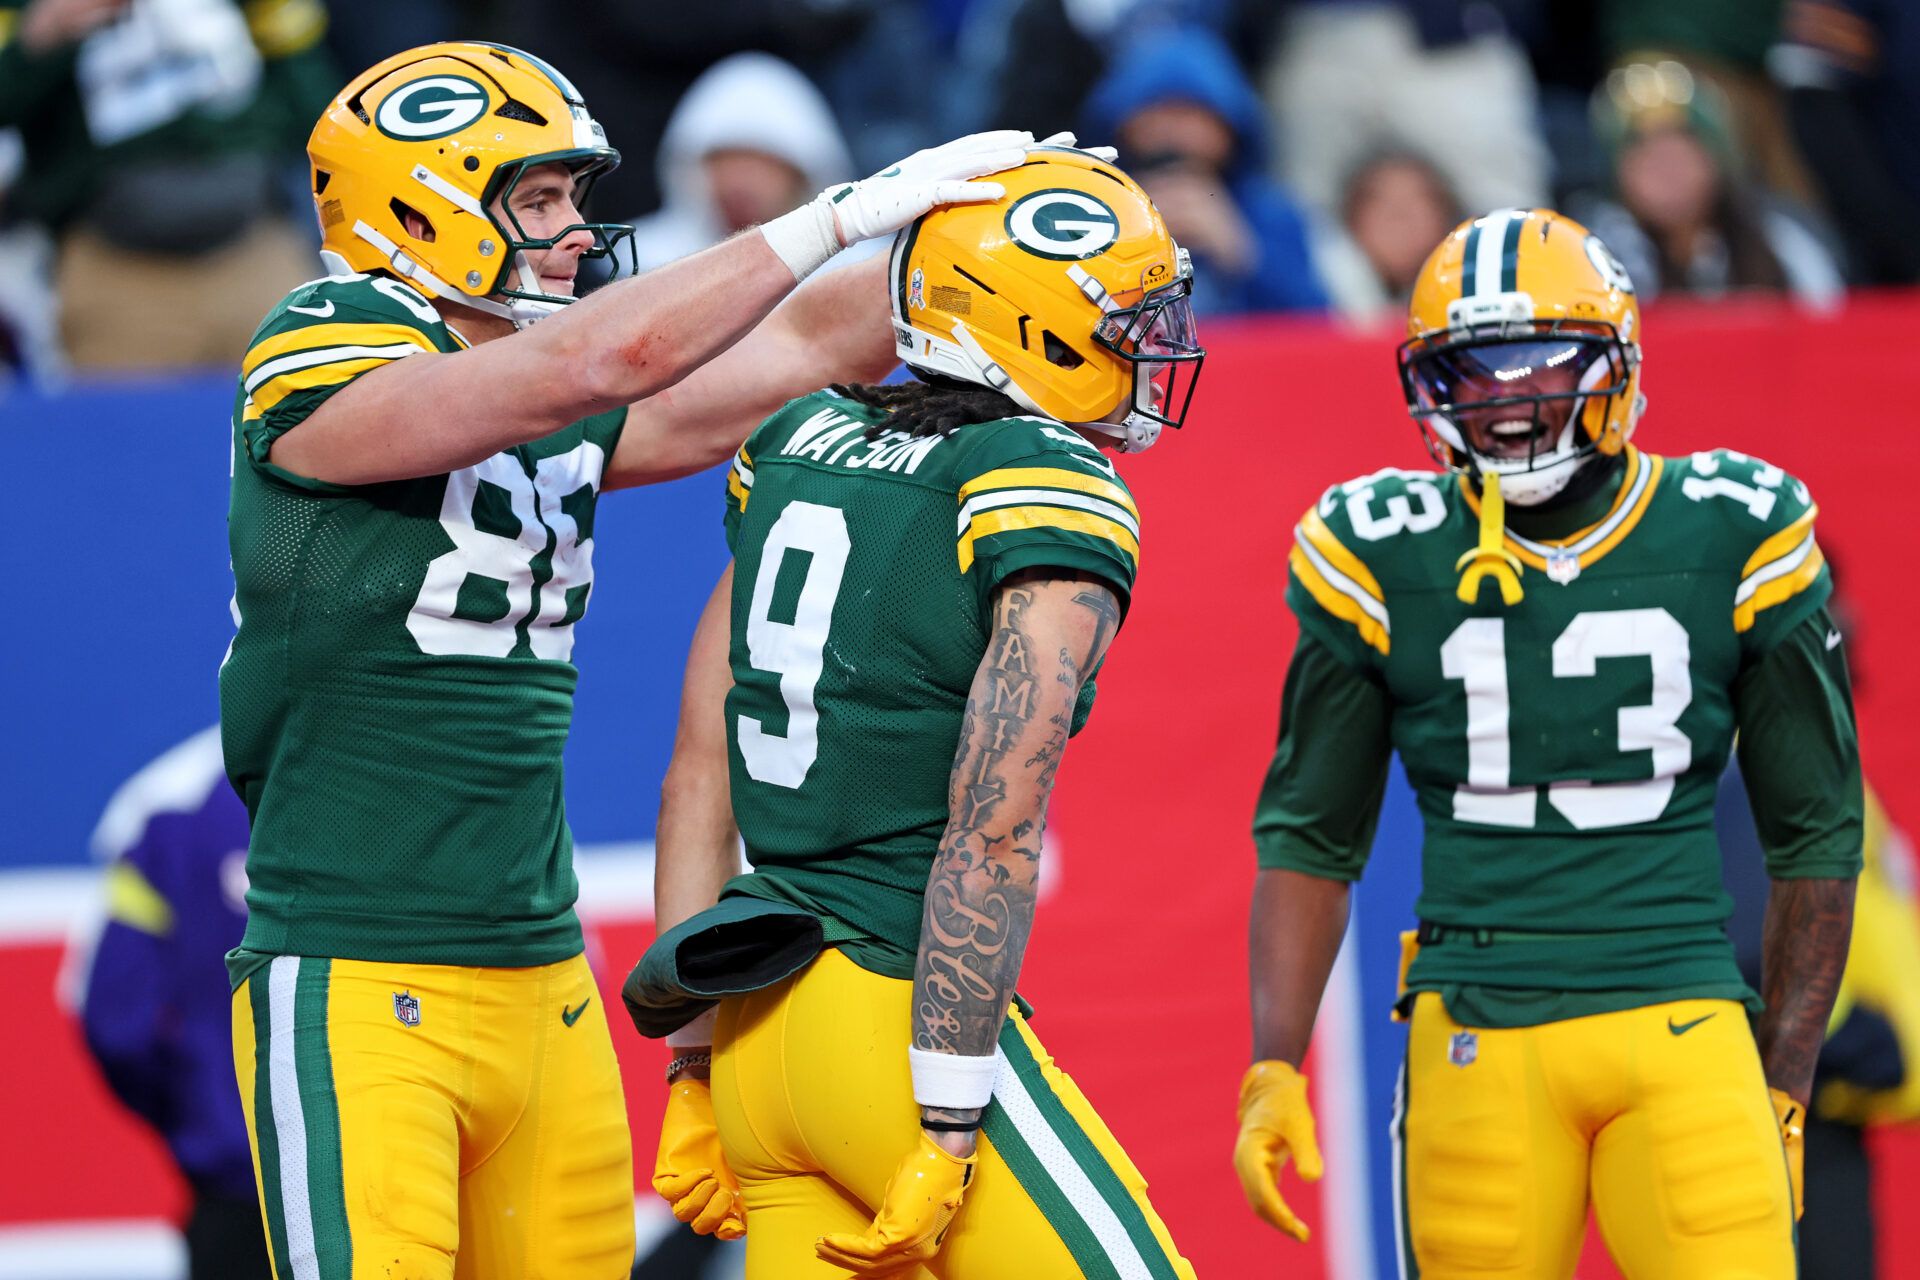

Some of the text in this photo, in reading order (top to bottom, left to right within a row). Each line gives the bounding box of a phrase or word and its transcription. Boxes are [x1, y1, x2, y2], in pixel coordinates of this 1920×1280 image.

[405, 439, 605, 662] 86
[780, 407, 961, 475] WATSON
[737, 500, 852, 789] 9
[968, 588, 1034, 829] FAMILY
[1440, 607, 1692, 830] 13
